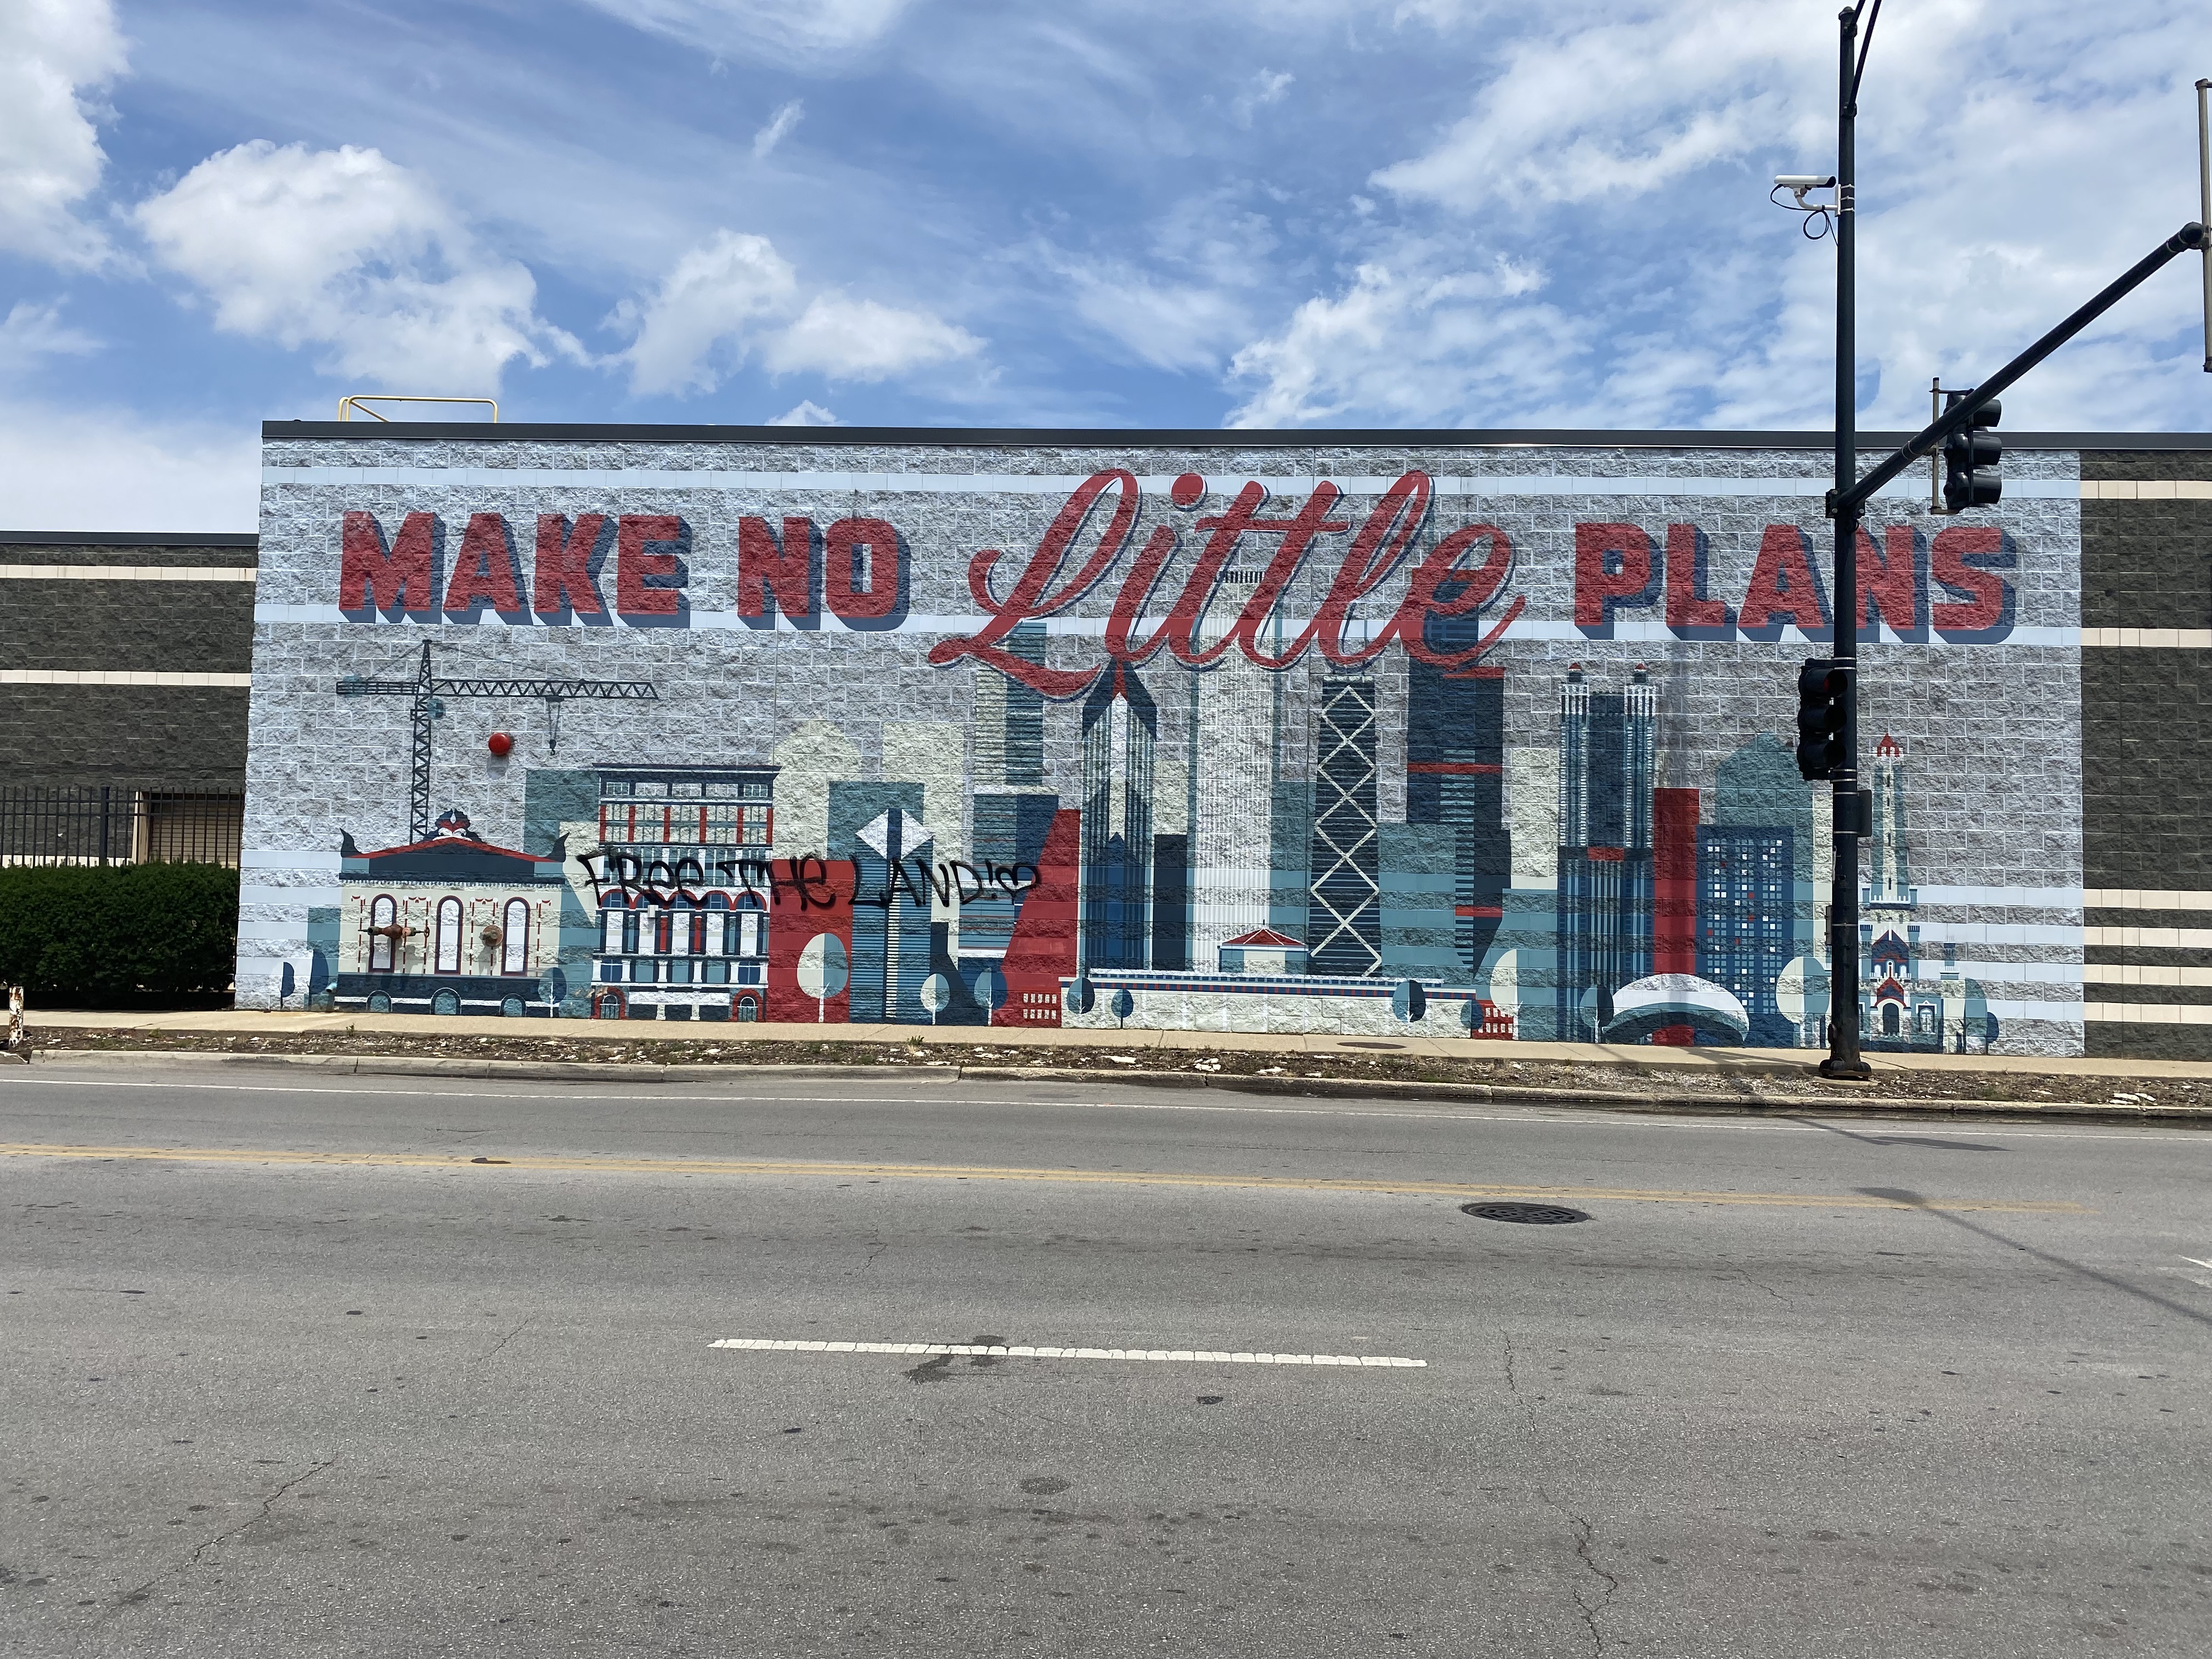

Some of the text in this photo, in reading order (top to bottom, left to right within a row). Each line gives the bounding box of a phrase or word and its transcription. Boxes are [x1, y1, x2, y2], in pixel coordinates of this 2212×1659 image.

[338, 468, 2005, 698] MAKE NO Little PLANS
